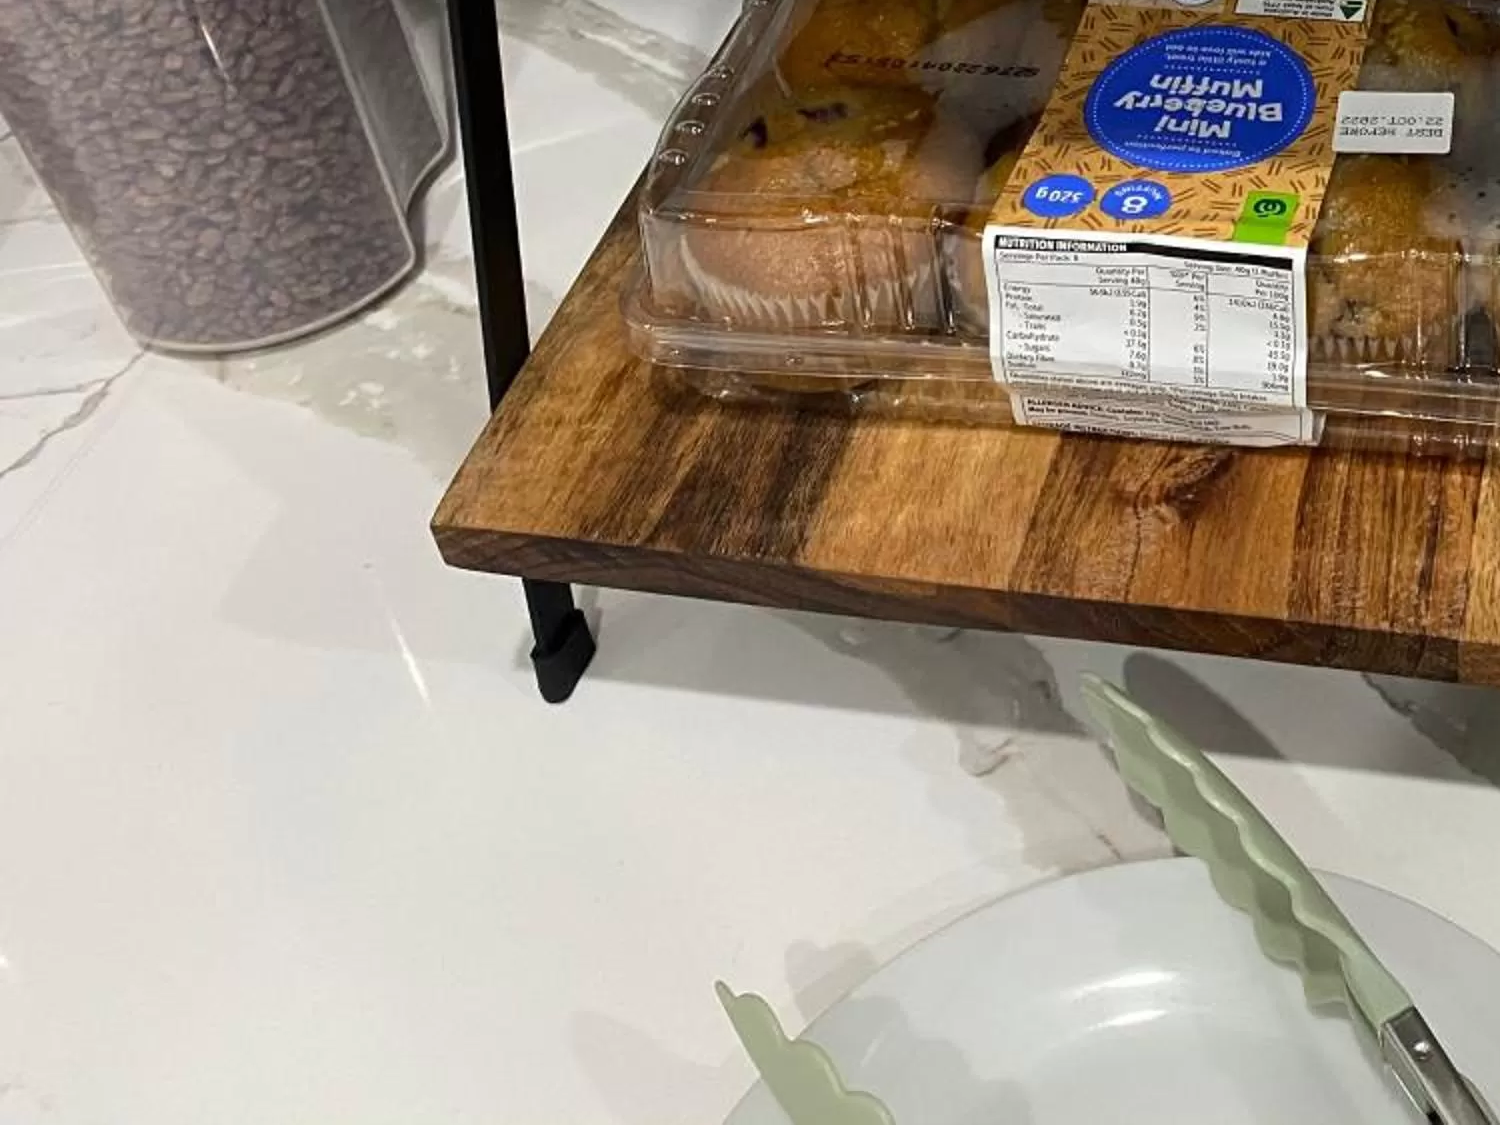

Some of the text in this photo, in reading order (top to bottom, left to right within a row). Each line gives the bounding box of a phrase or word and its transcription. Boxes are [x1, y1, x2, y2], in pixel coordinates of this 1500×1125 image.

[1149, 74, 1263, 99] Muffin
[1113, 90, 1283, 122] Blueberry
[1153, 114, 1231, 138] Mini
[1035, 185, 1084, 204] 320g
[1120, 195, 1148, 214] 8
[998, 236, 1127, 252] NUTRITION INFORMATION
